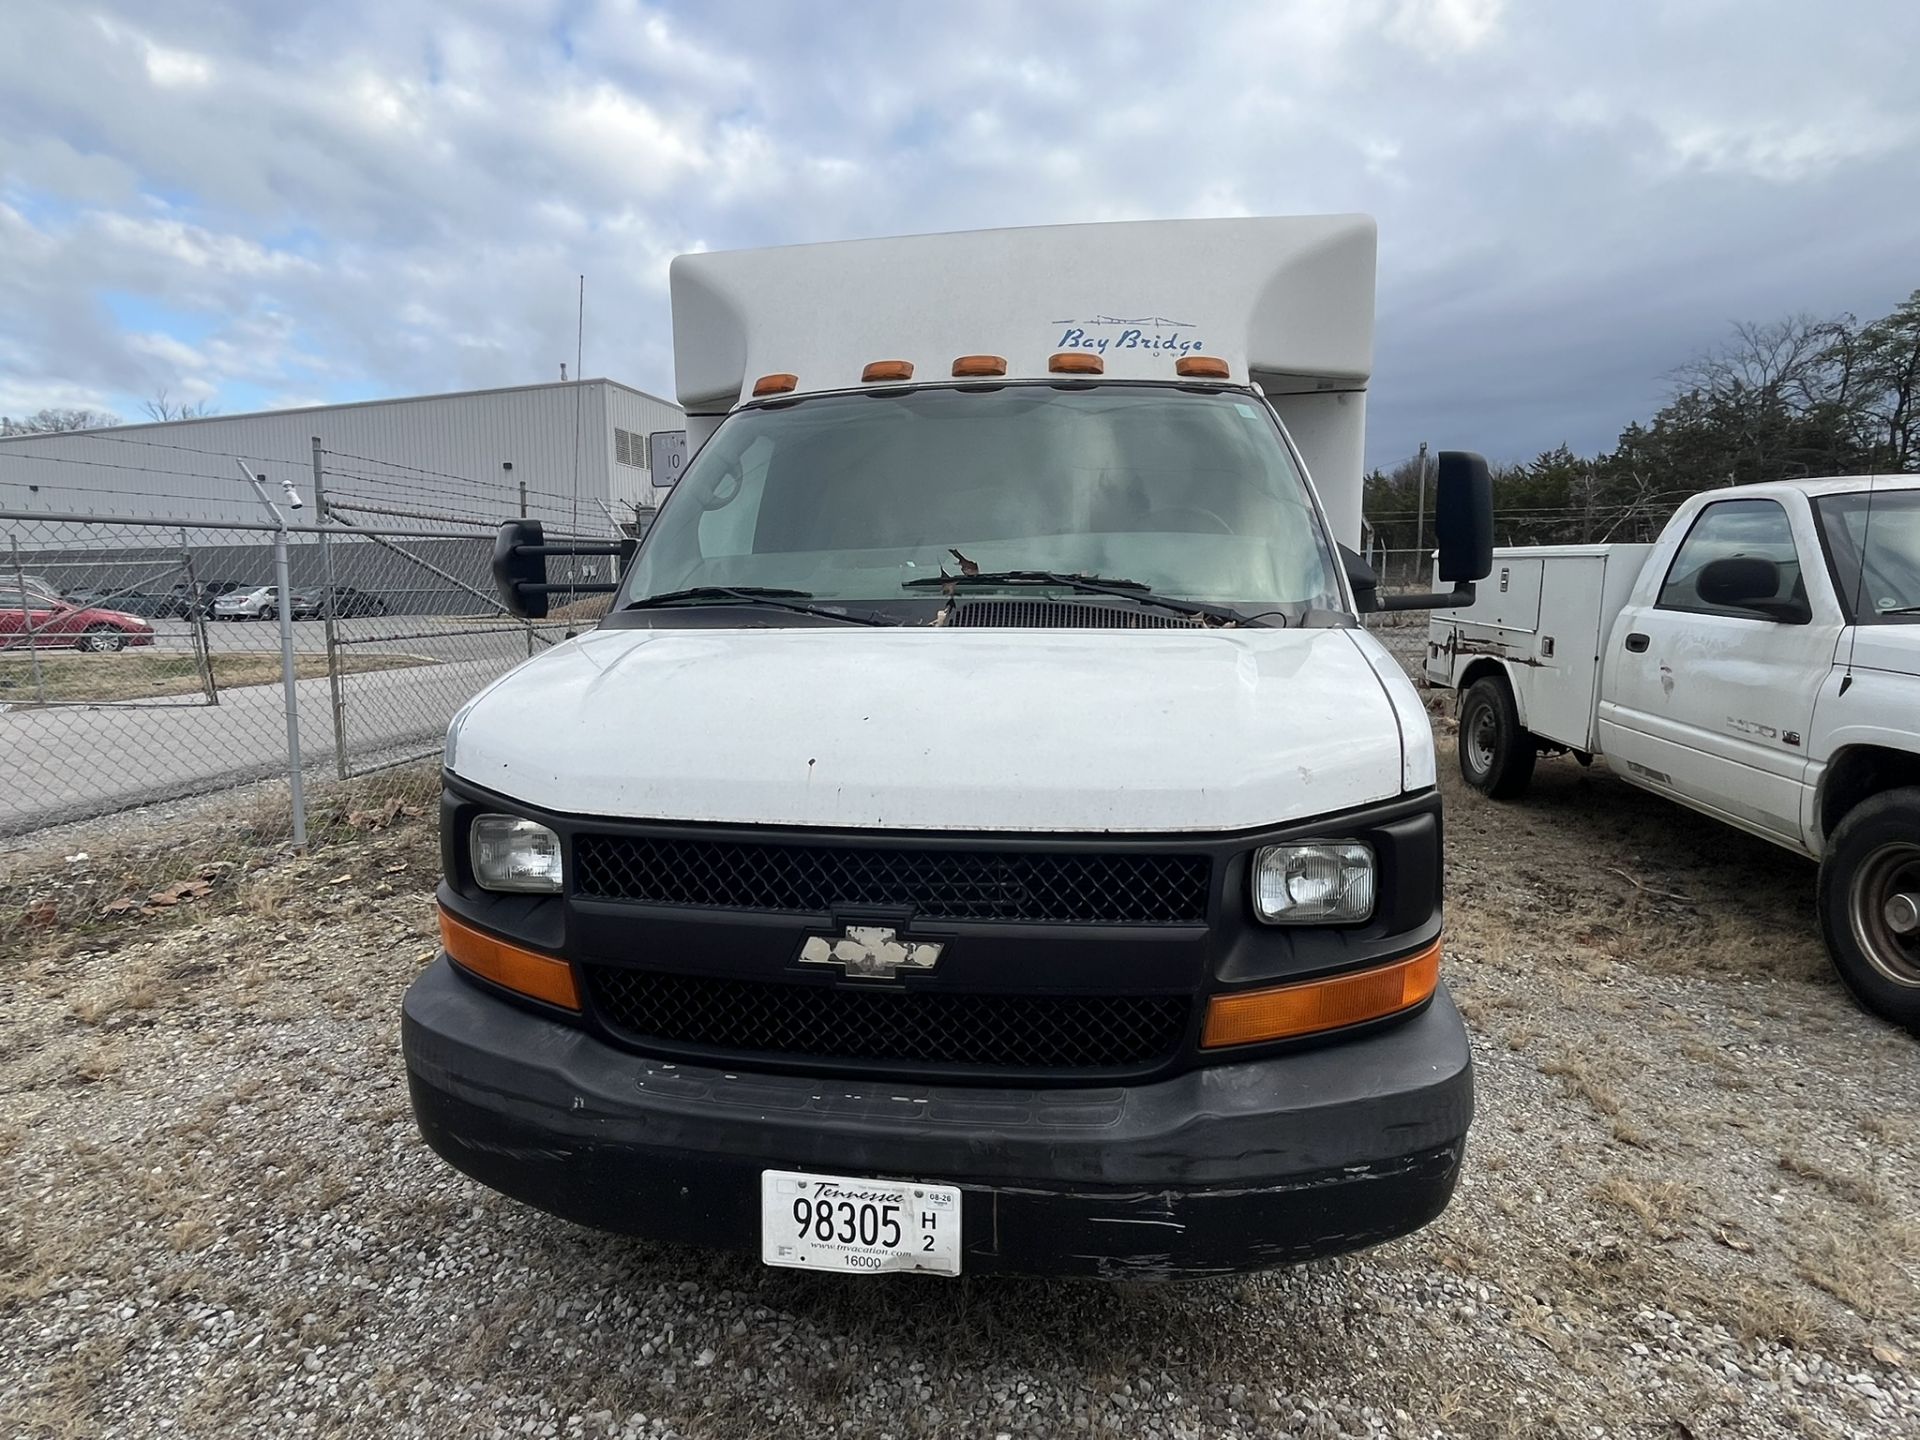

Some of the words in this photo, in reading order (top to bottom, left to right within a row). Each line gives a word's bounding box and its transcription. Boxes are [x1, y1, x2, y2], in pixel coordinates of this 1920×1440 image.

[1058, 328, 1109, 354] Bay
[1115, 329, 1203, 356] Bridge
[667, 454, 680, 469] 10
[813, 1182, 904, 1203] Tennessee
[793, 1198, 901, 1248] 98305
[922, 1211, 937, 1230] H
[922, 1235, 935, 1252] 2
[845, 1254, 882, 1269] 16000
